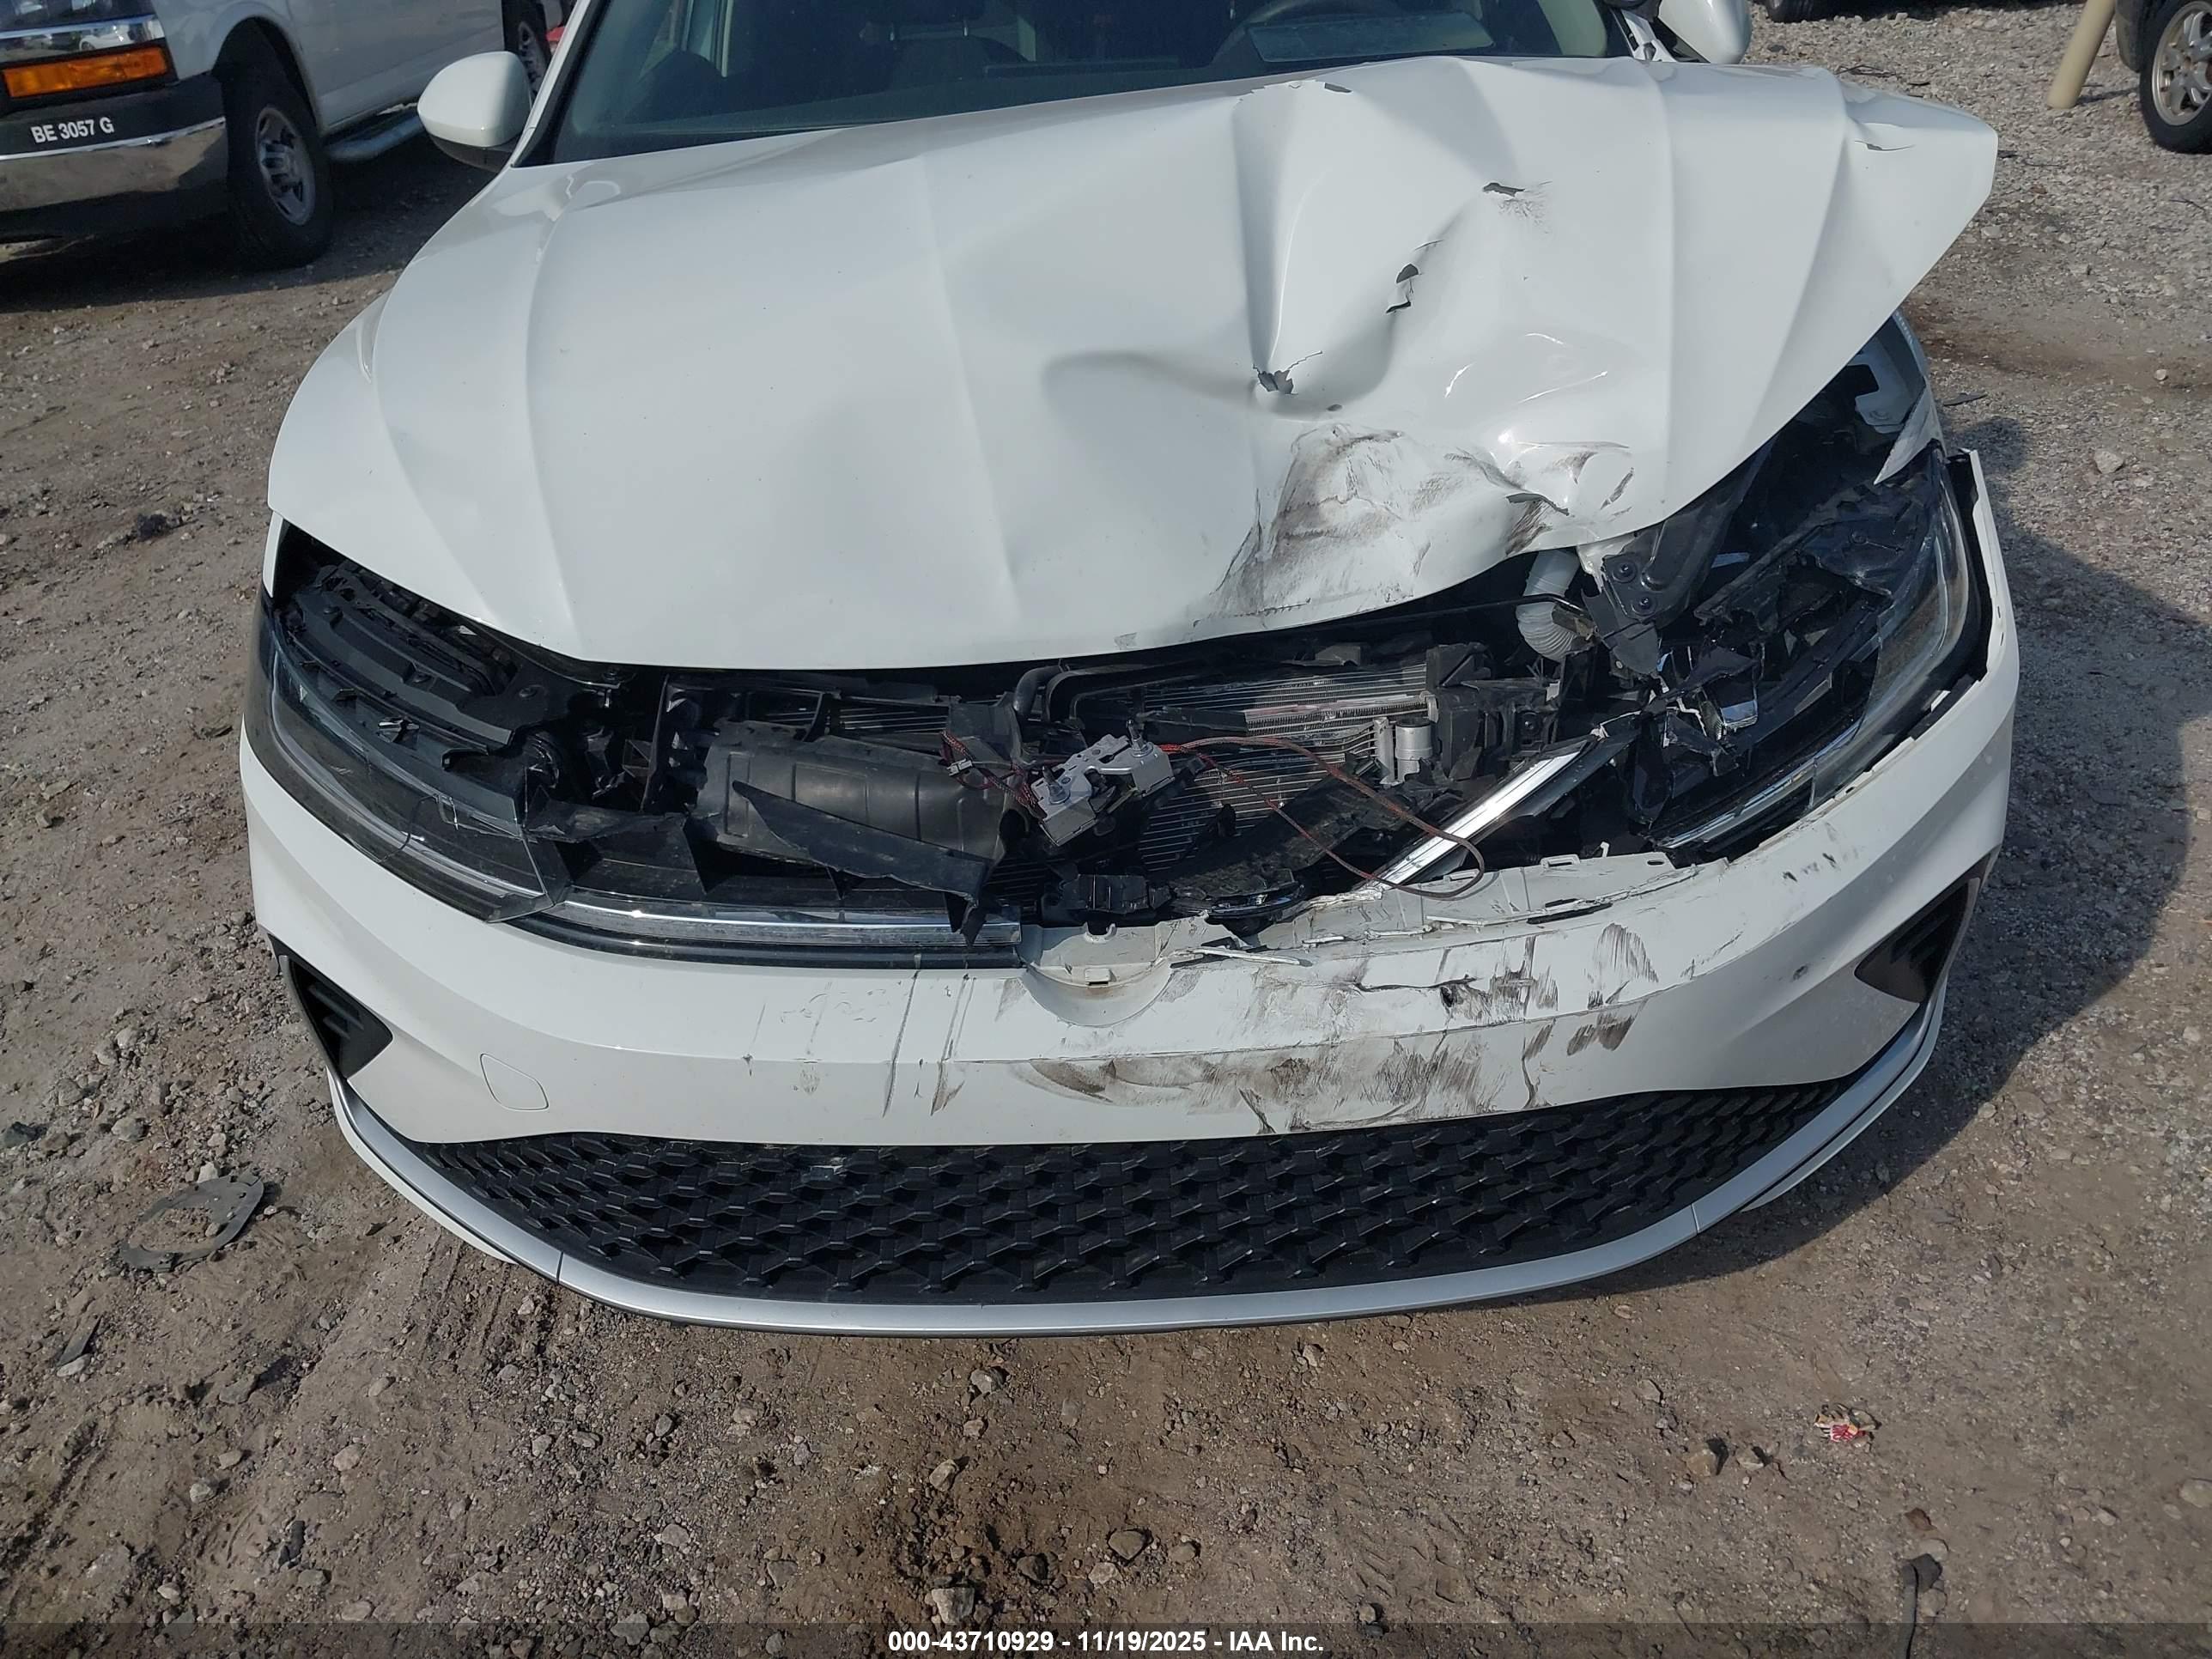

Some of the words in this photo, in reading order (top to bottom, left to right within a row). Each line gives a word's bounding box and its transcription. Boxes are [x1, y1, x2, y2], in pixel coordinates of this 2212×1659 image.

[30, 125, 58, 143] BE
[58, 119, 95, 139] 3057
[99, 117, 115, 134] G
